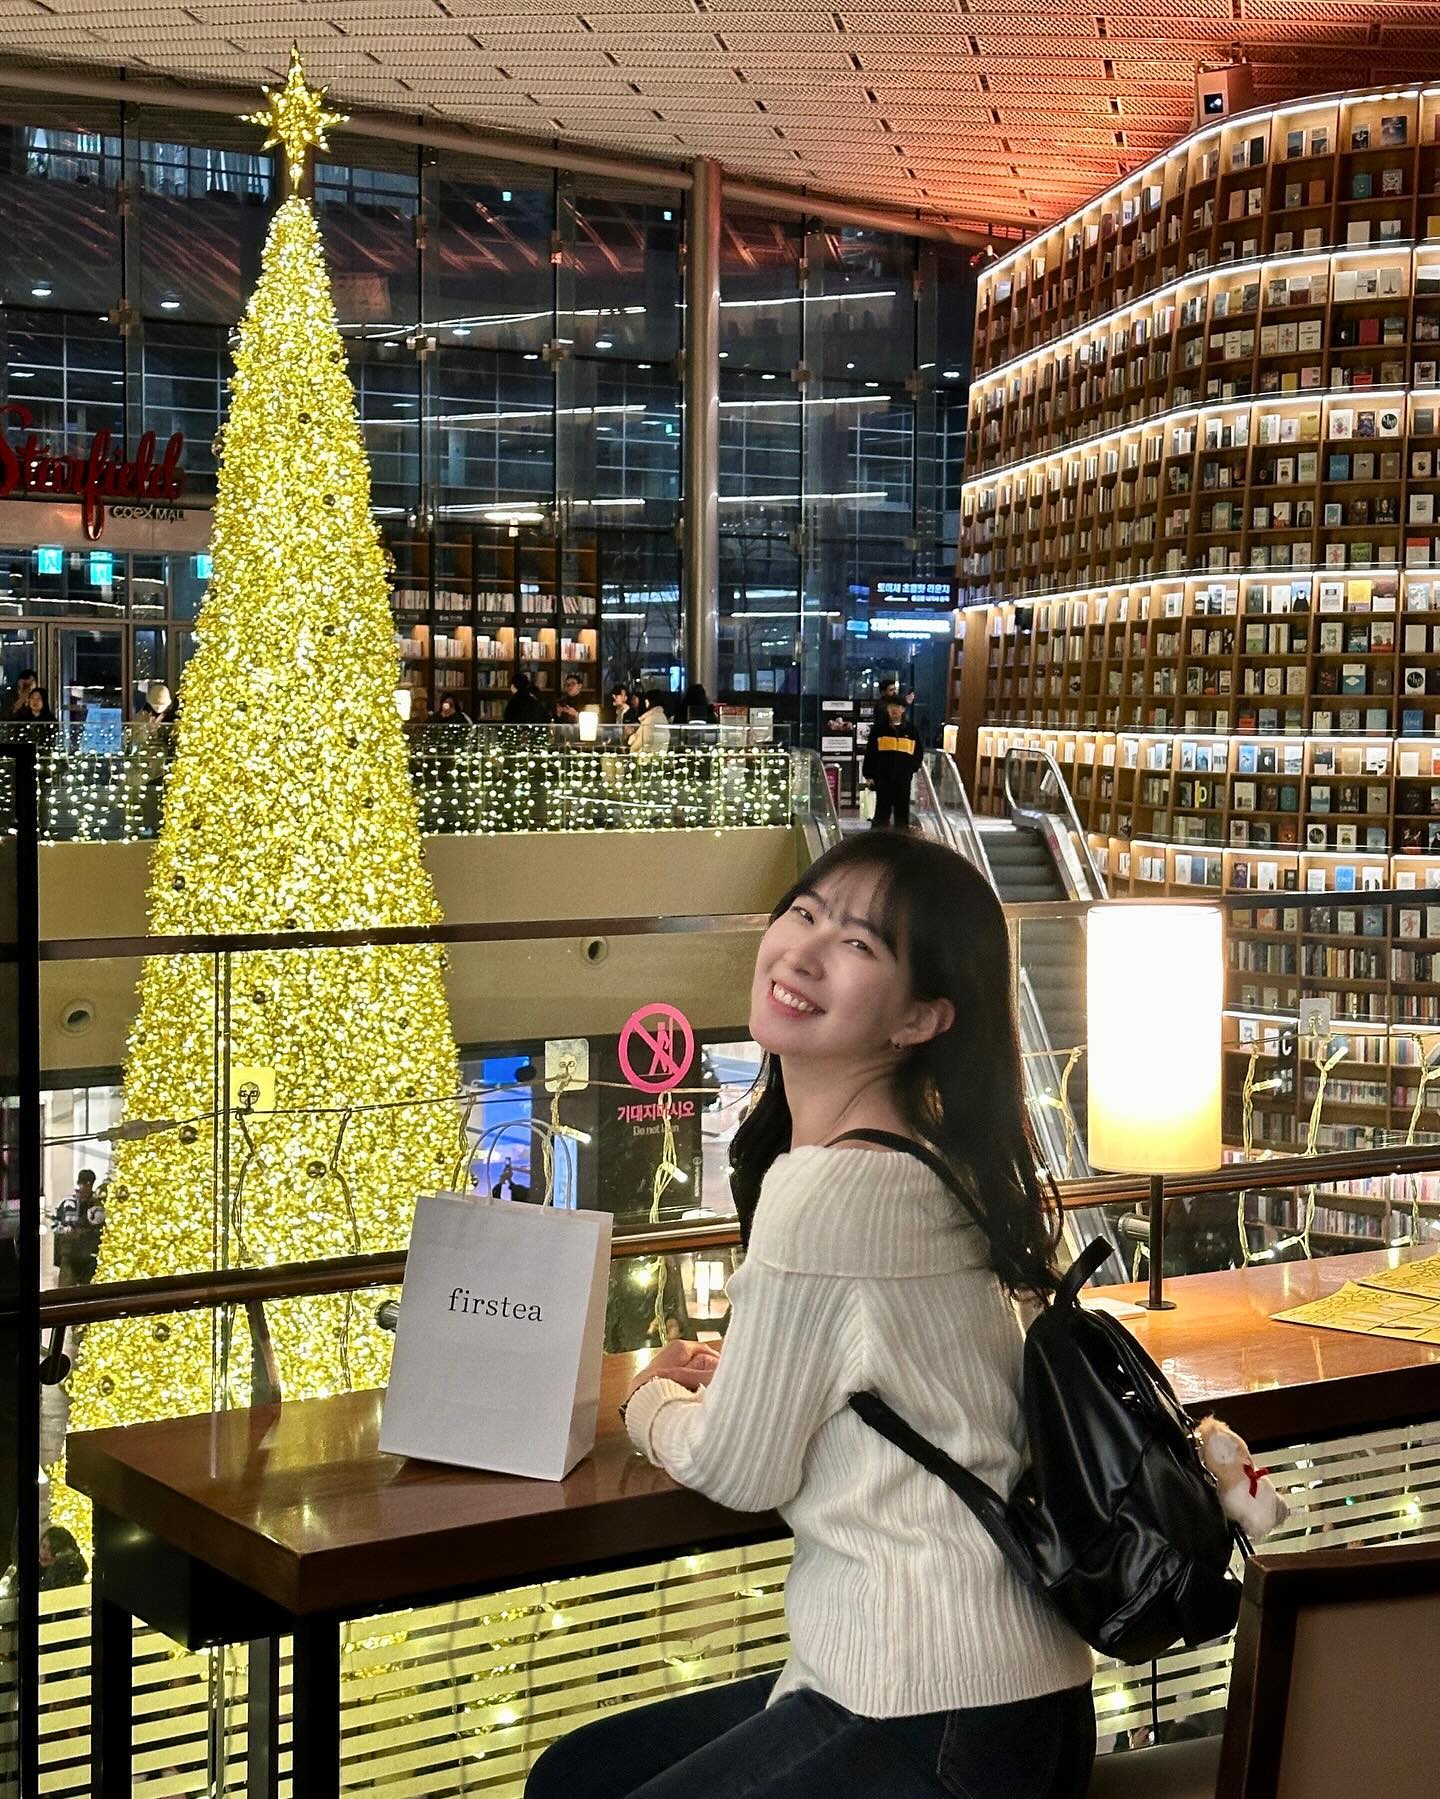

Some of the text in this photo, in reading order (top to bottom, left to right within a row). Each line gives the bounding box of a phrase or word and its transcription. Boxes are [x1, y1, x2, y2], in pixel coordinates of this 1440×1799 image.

[633, 1125, 645, 1136] Do
[646, 1124, 660, 1134] not
[448, 1287, 543, 1322] firstea
